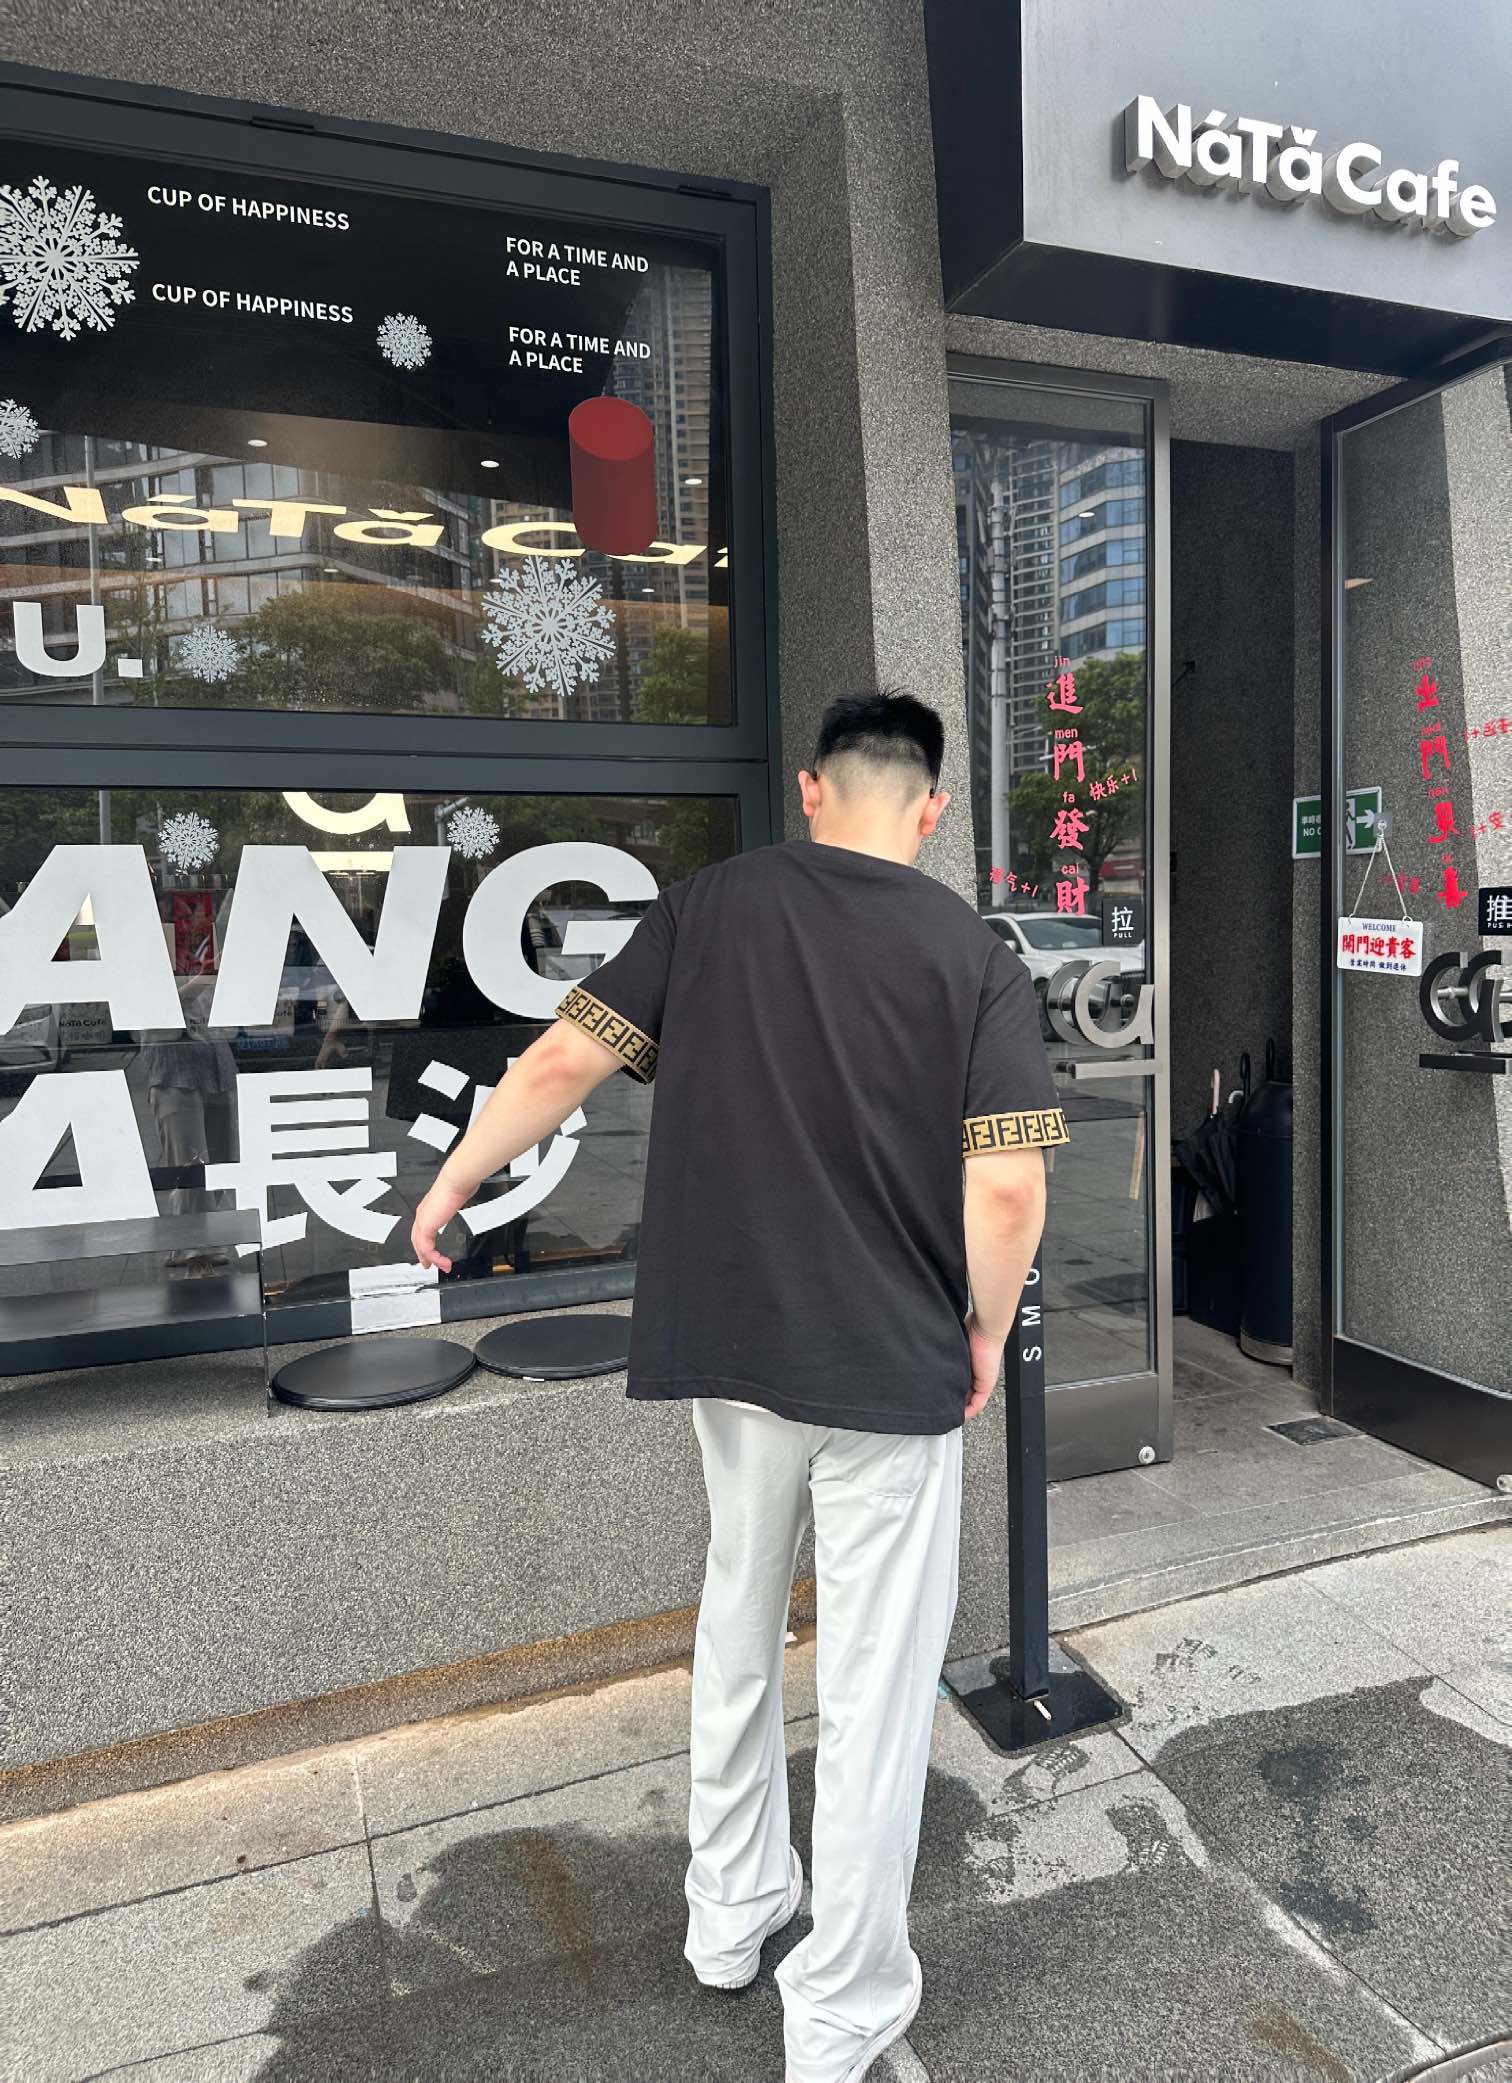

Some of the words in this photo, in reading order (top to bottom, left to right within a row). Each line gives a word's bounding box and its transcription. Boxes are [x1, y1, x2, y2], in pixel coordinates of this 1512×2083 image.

[1336, 142, 1496, 229] Cafe
[147, 186, 192, 207] CUP
[198, 193, 226, 213] OF
[232, 198, 350, 230] HAPPINESS
[506, 236, 544, 258] FOR
[548, 243, 561, 261] A
[564, 245, 608, 268] TIME
[611, 253, 649, 273] AND
[506, 260, 519, 278] A
[523, 262, 581, 286] PLACE
[152, 283, 197, 304] CUP
[202, 289, 231, 309] OF
[236, 292, 354, 323] HAPPINESS
[509, 326, 547, 347] FOR
[550, 332, 563, 349] A
[566, 334, 610, 355] TIME
[613, 340, 651, 360] AND
[508, 350, 522, 367] A
[526, 351, 584, 374] PLACE
[1054, 728, 1079, 740] men
[1111, 906, 1134, 933] 拉
[1362, 923, 1397, 933] WELCOME
[1342, 933, 1416, 959] 開門迎貴客
